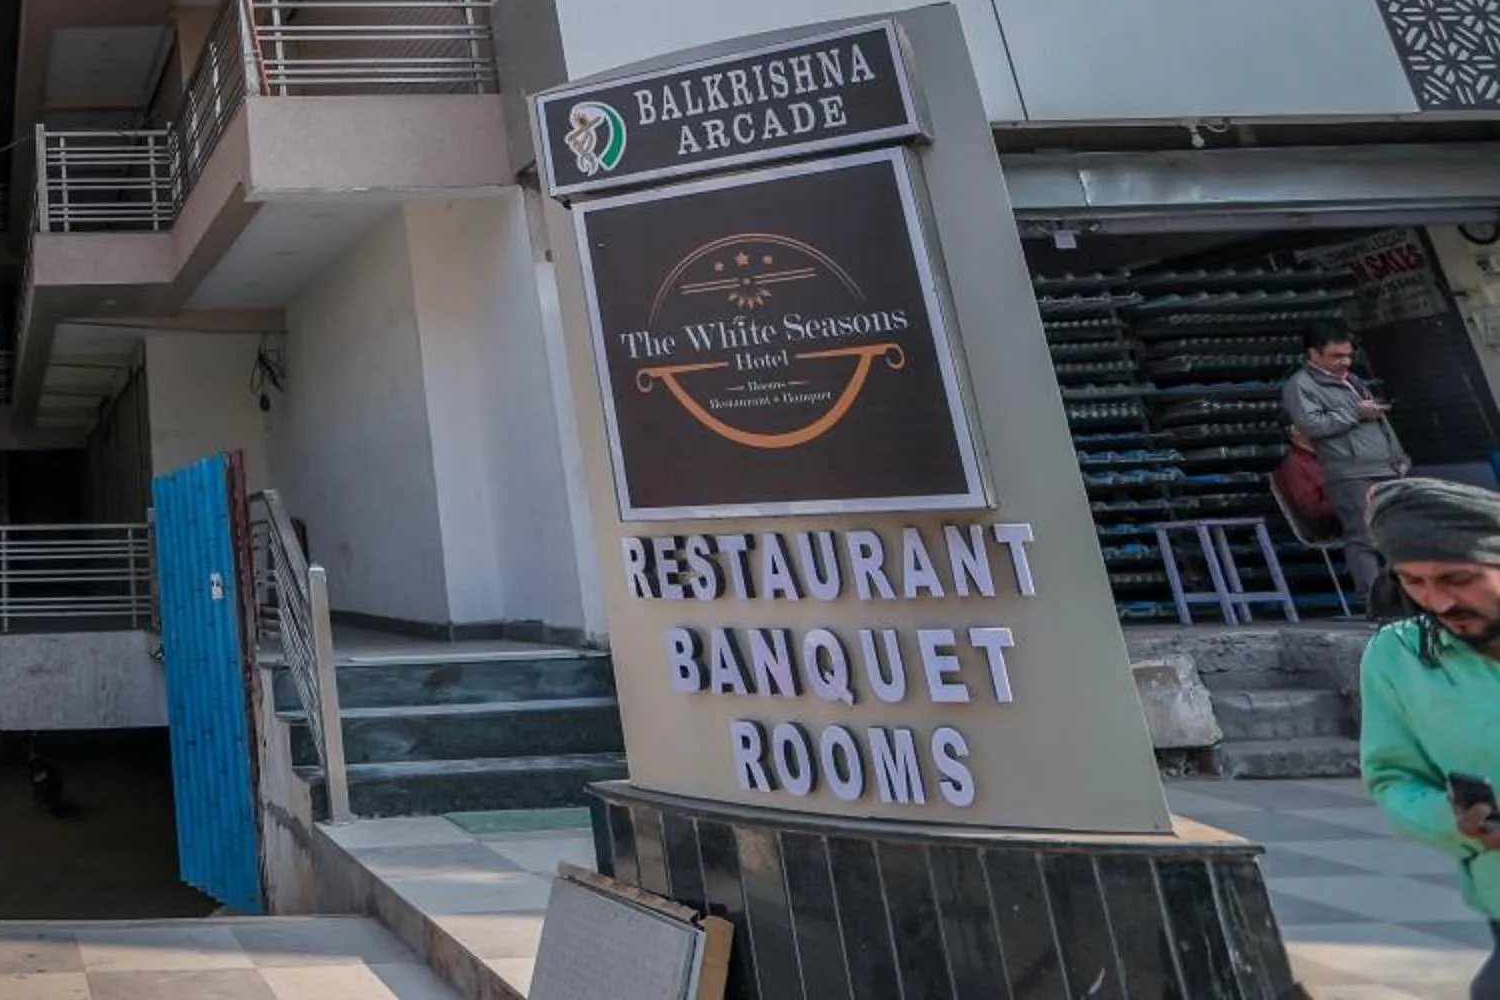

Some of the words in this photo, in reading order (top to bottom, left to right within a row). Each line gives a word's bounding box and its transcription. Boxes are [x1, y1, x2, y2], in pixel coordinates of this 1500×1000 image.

[633, 43, 876, 126] BALKRISHNA
[677, 96, 847, 156] ARCADE
[620, 331, 676, 359] The
[684, 315, 777, 352] White
[784, 309, 908, 341] Seasons
[734, 350, 790, 372] Hotel
[621, 523, 1036, 601] RESTAURANT
[664, 627, 1015, 706] BANQUET
[730, 718, 976, 807] ROOMS
